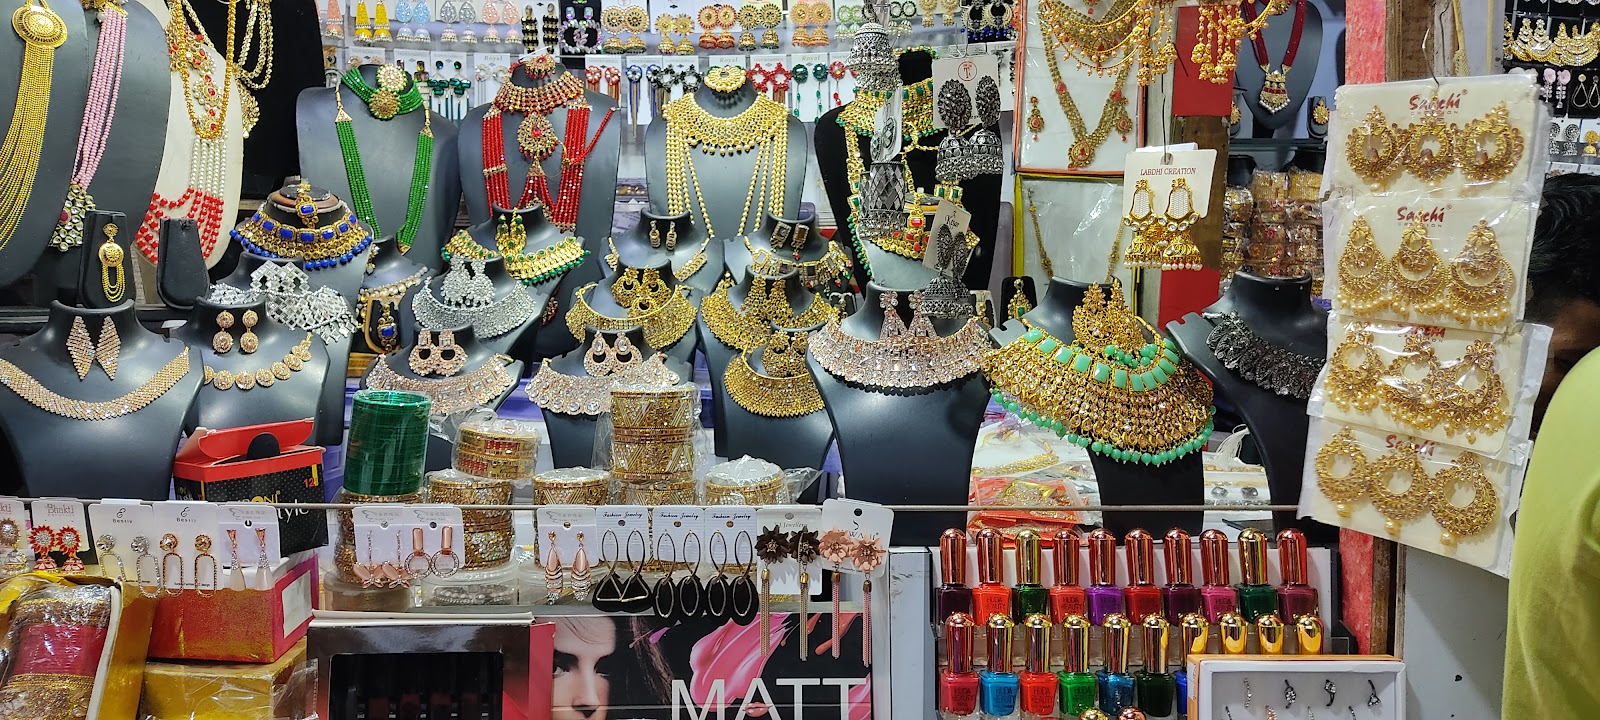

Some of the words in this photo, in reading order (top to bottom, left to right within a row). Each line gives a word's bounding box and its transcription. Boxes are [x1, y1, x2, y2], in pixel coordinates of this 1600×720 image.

[484, 55, 503, 63] Royal
[801, 55, 820, 63] Royal
[1164, 167, 1197, 175] CREATION
[1397, 206, 1445, 223] Sachi
[0, 503, 12, 513] kti
[46, 503, 75, 514] Bhakti
[624, 511, 643, 519] Jewelry
[680, 512, 699, 520] Jewelry
[671, 678, 867, 720] MATT
